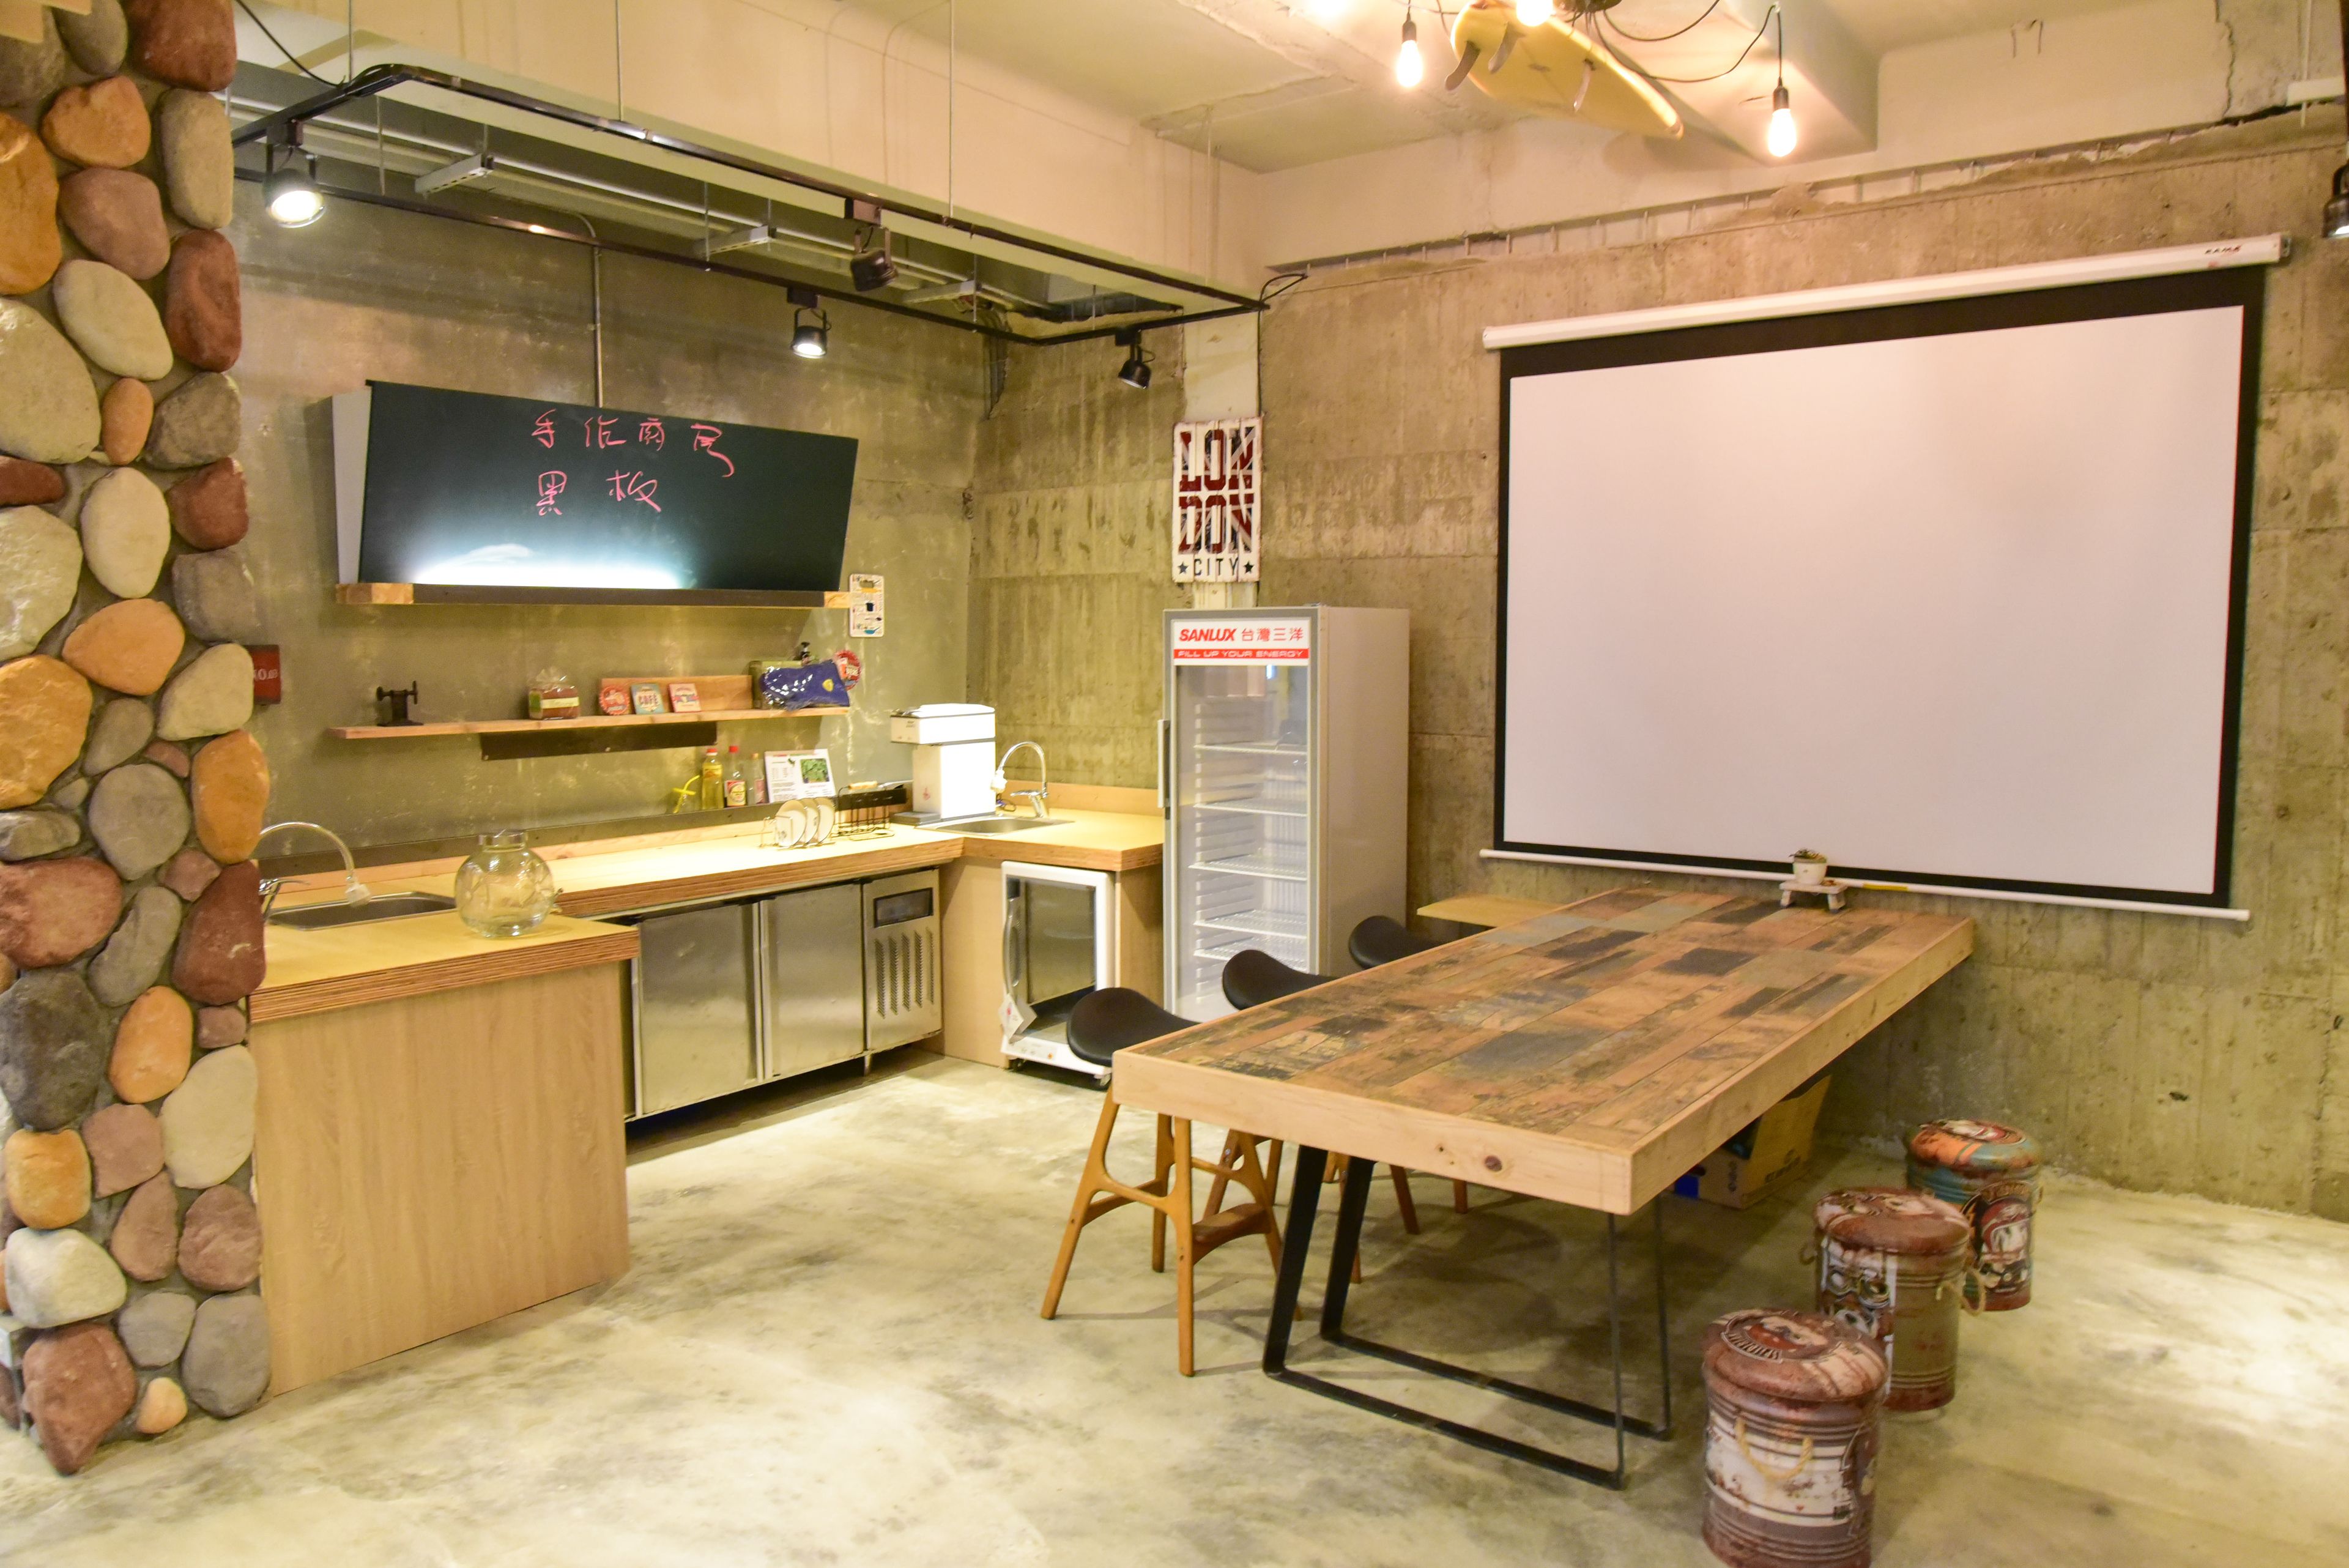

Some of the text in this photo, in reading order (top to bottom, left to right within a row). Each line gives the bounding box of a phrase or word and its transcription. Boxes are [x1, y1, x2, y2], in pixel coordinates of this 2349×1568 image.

[536, 469, 661, 516] 黑板
[1178, 493, 1255, 554] DON
[1193, 557, 1239, 576] CITY
[1179, 627, 1304, 642] SANLUX 台灣三洋
